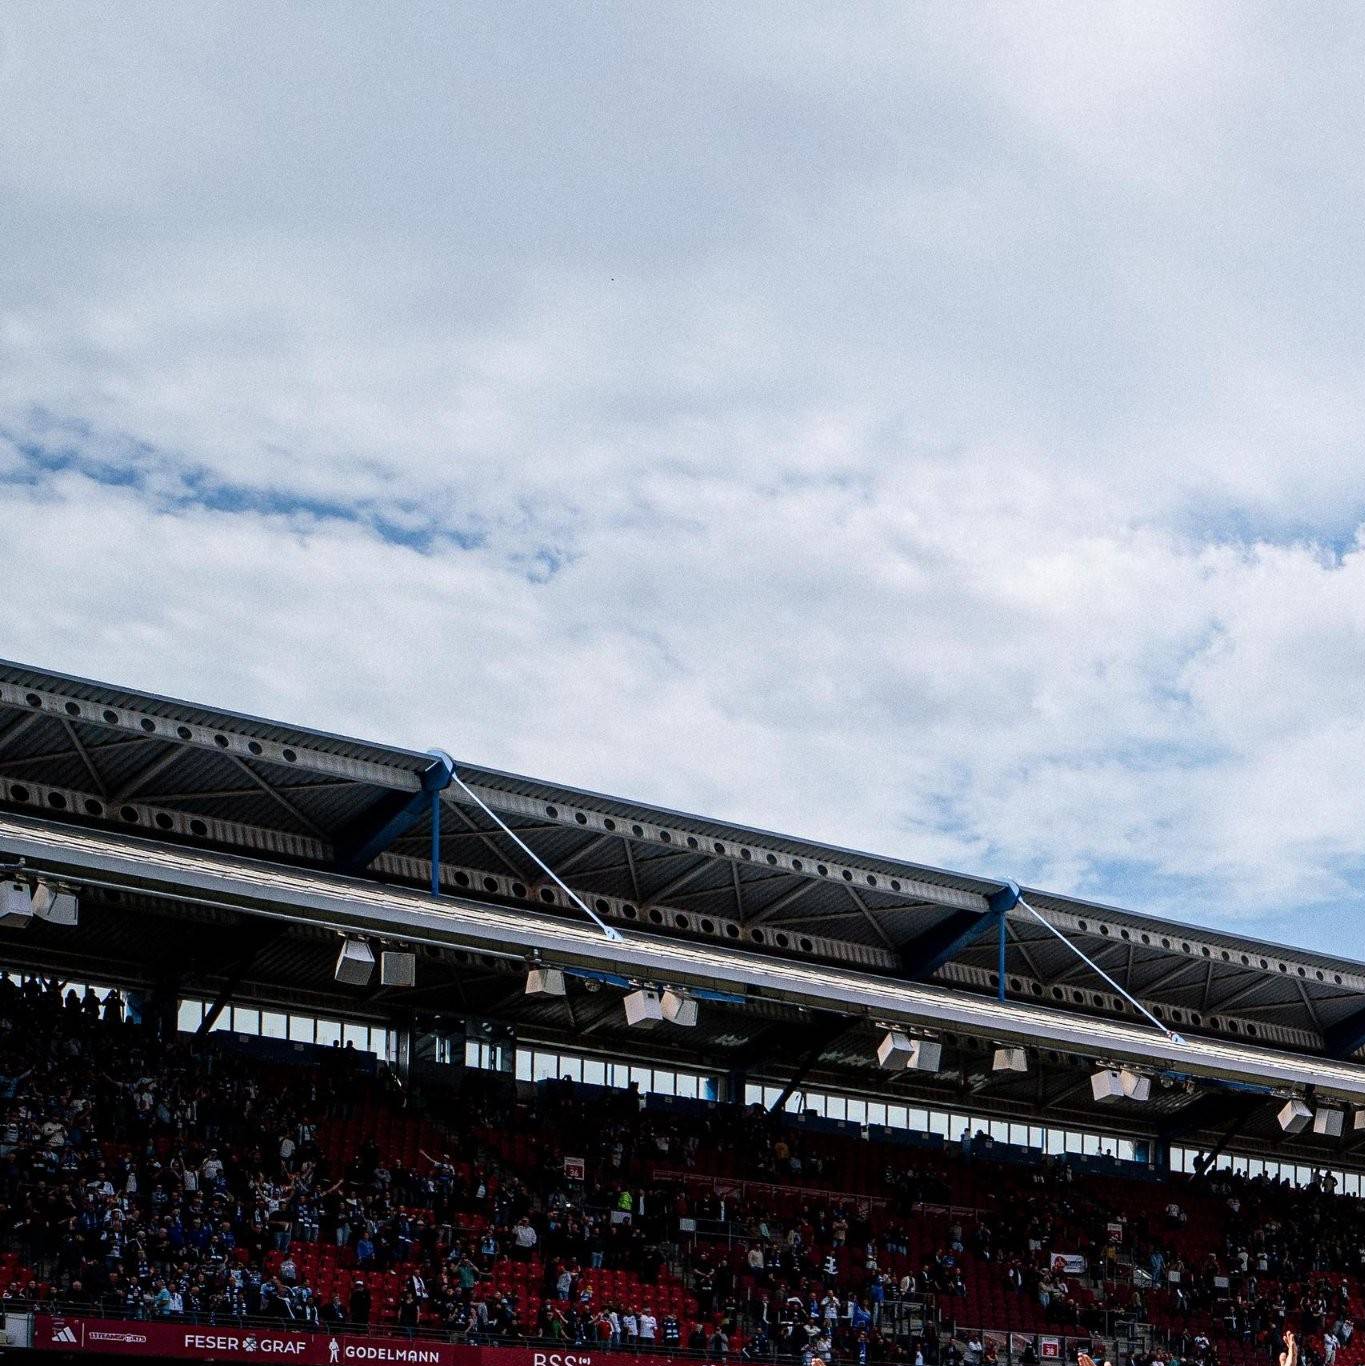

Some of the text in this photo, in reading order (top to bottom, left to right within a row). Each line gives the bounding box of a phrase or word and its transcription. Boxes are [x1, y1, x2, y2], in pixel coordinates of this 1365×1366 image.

[184, 1334, 307, 1354] FESER GRAF
[345, 1345, 440, 1363] GODELMANN
